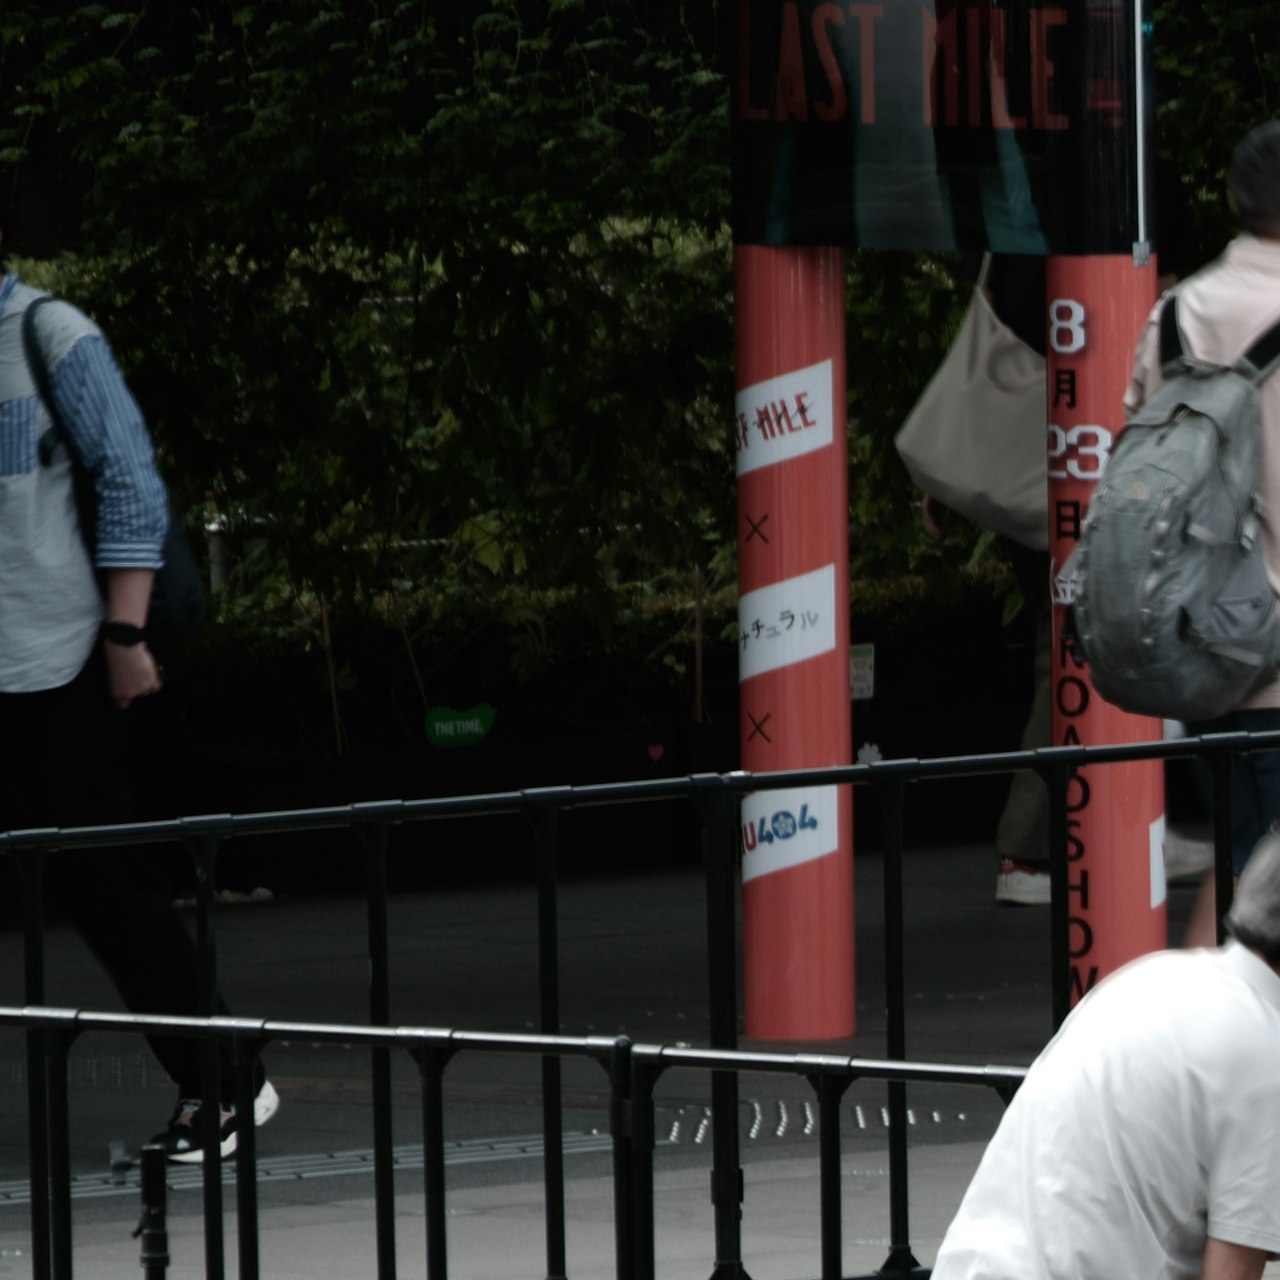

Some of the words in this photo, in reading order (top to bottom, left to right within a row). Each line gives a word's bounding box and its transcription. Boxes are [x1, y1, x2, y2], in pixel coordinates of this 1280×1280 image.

[738, 0, 884, 125] LAST
[922, 4, 1070, 132] MILE
[755, 391, 816, 441] MILE
